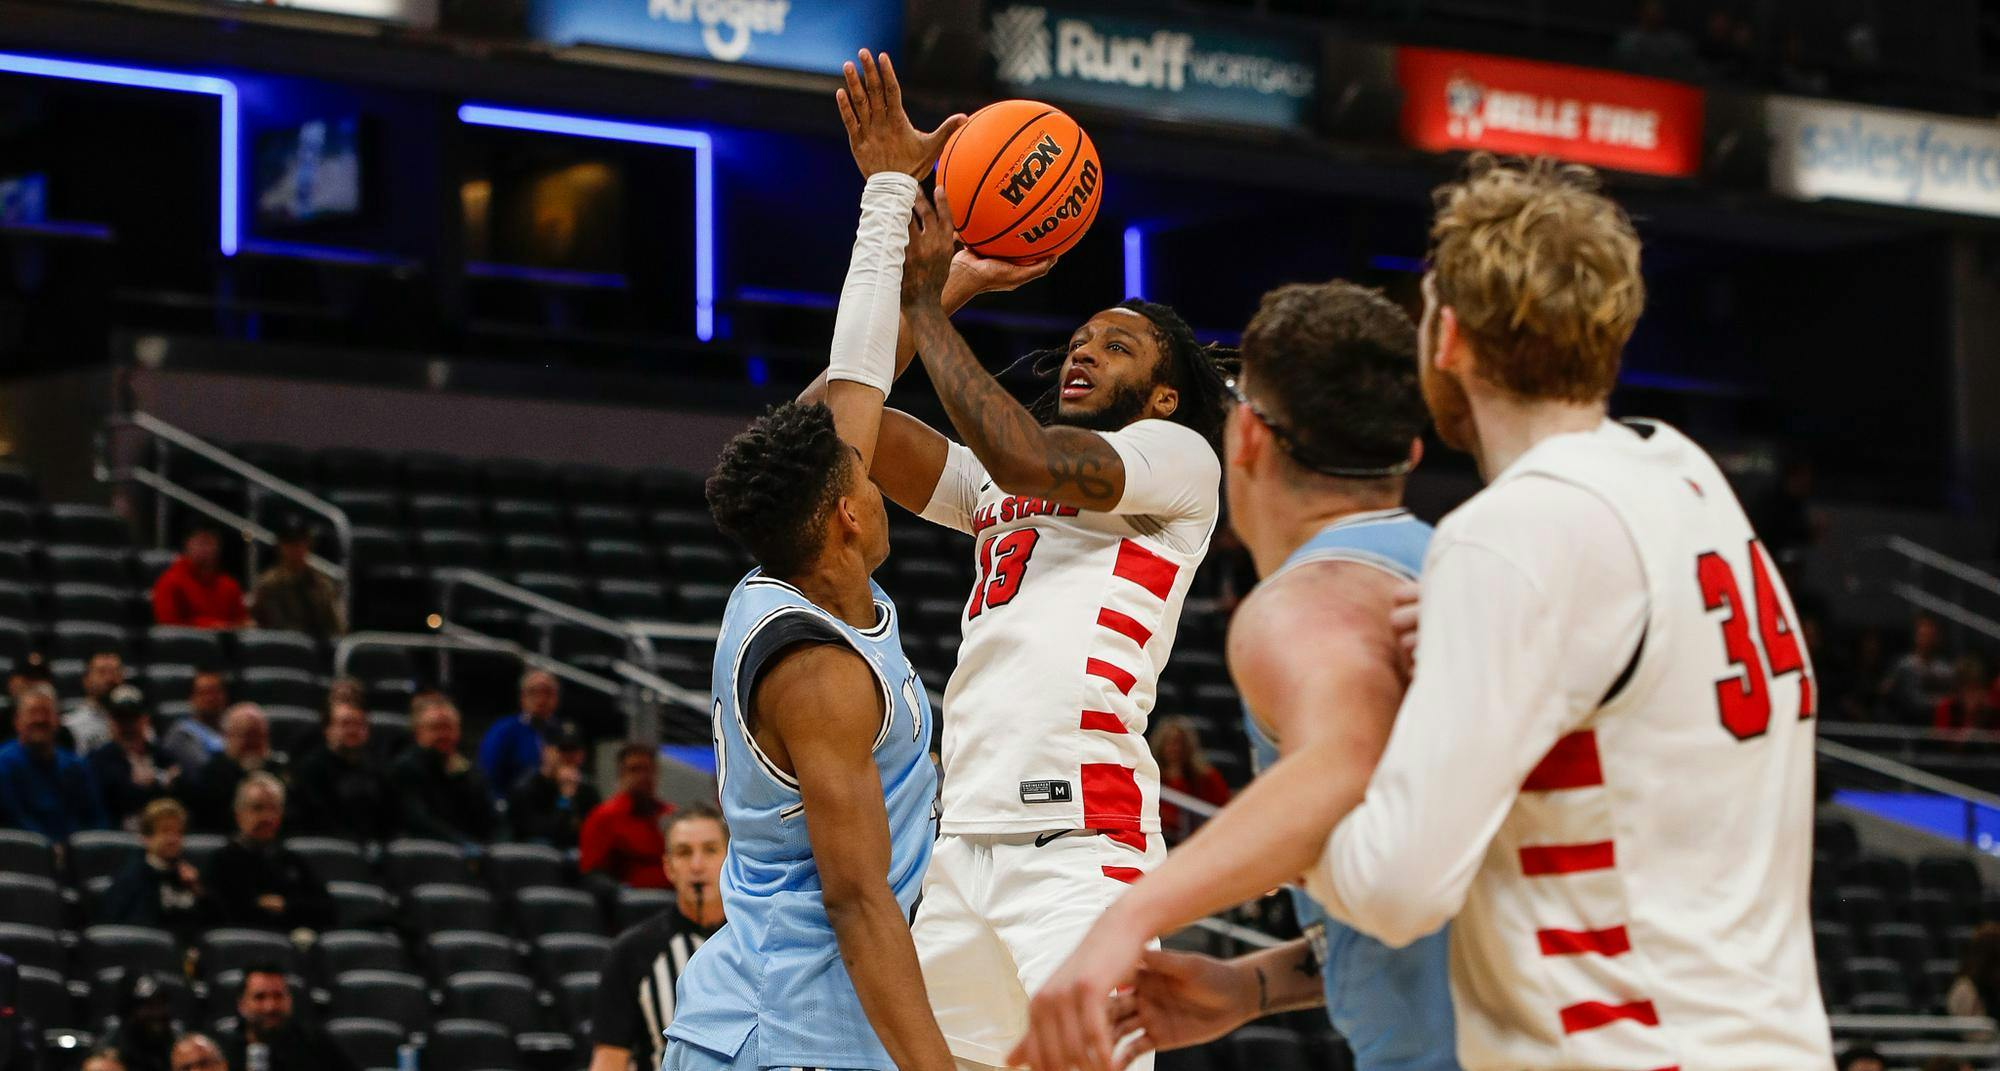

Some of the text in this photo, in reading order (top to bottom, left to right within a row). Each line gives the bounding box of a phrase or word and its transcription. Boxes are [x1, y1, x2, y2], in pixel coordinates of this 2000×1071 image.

[1057, 20, 1193, 91] Ruoff
[999, 134, 1062, 206] NCAA
[1803, 112, 2000, 203] salesforc
[1019, 159, 1099, 243] Wilson
[968, 528, 1040, 621] 13
[1695, 537, 1814, 741] 34
[1055, 786, 1065, 796] M
